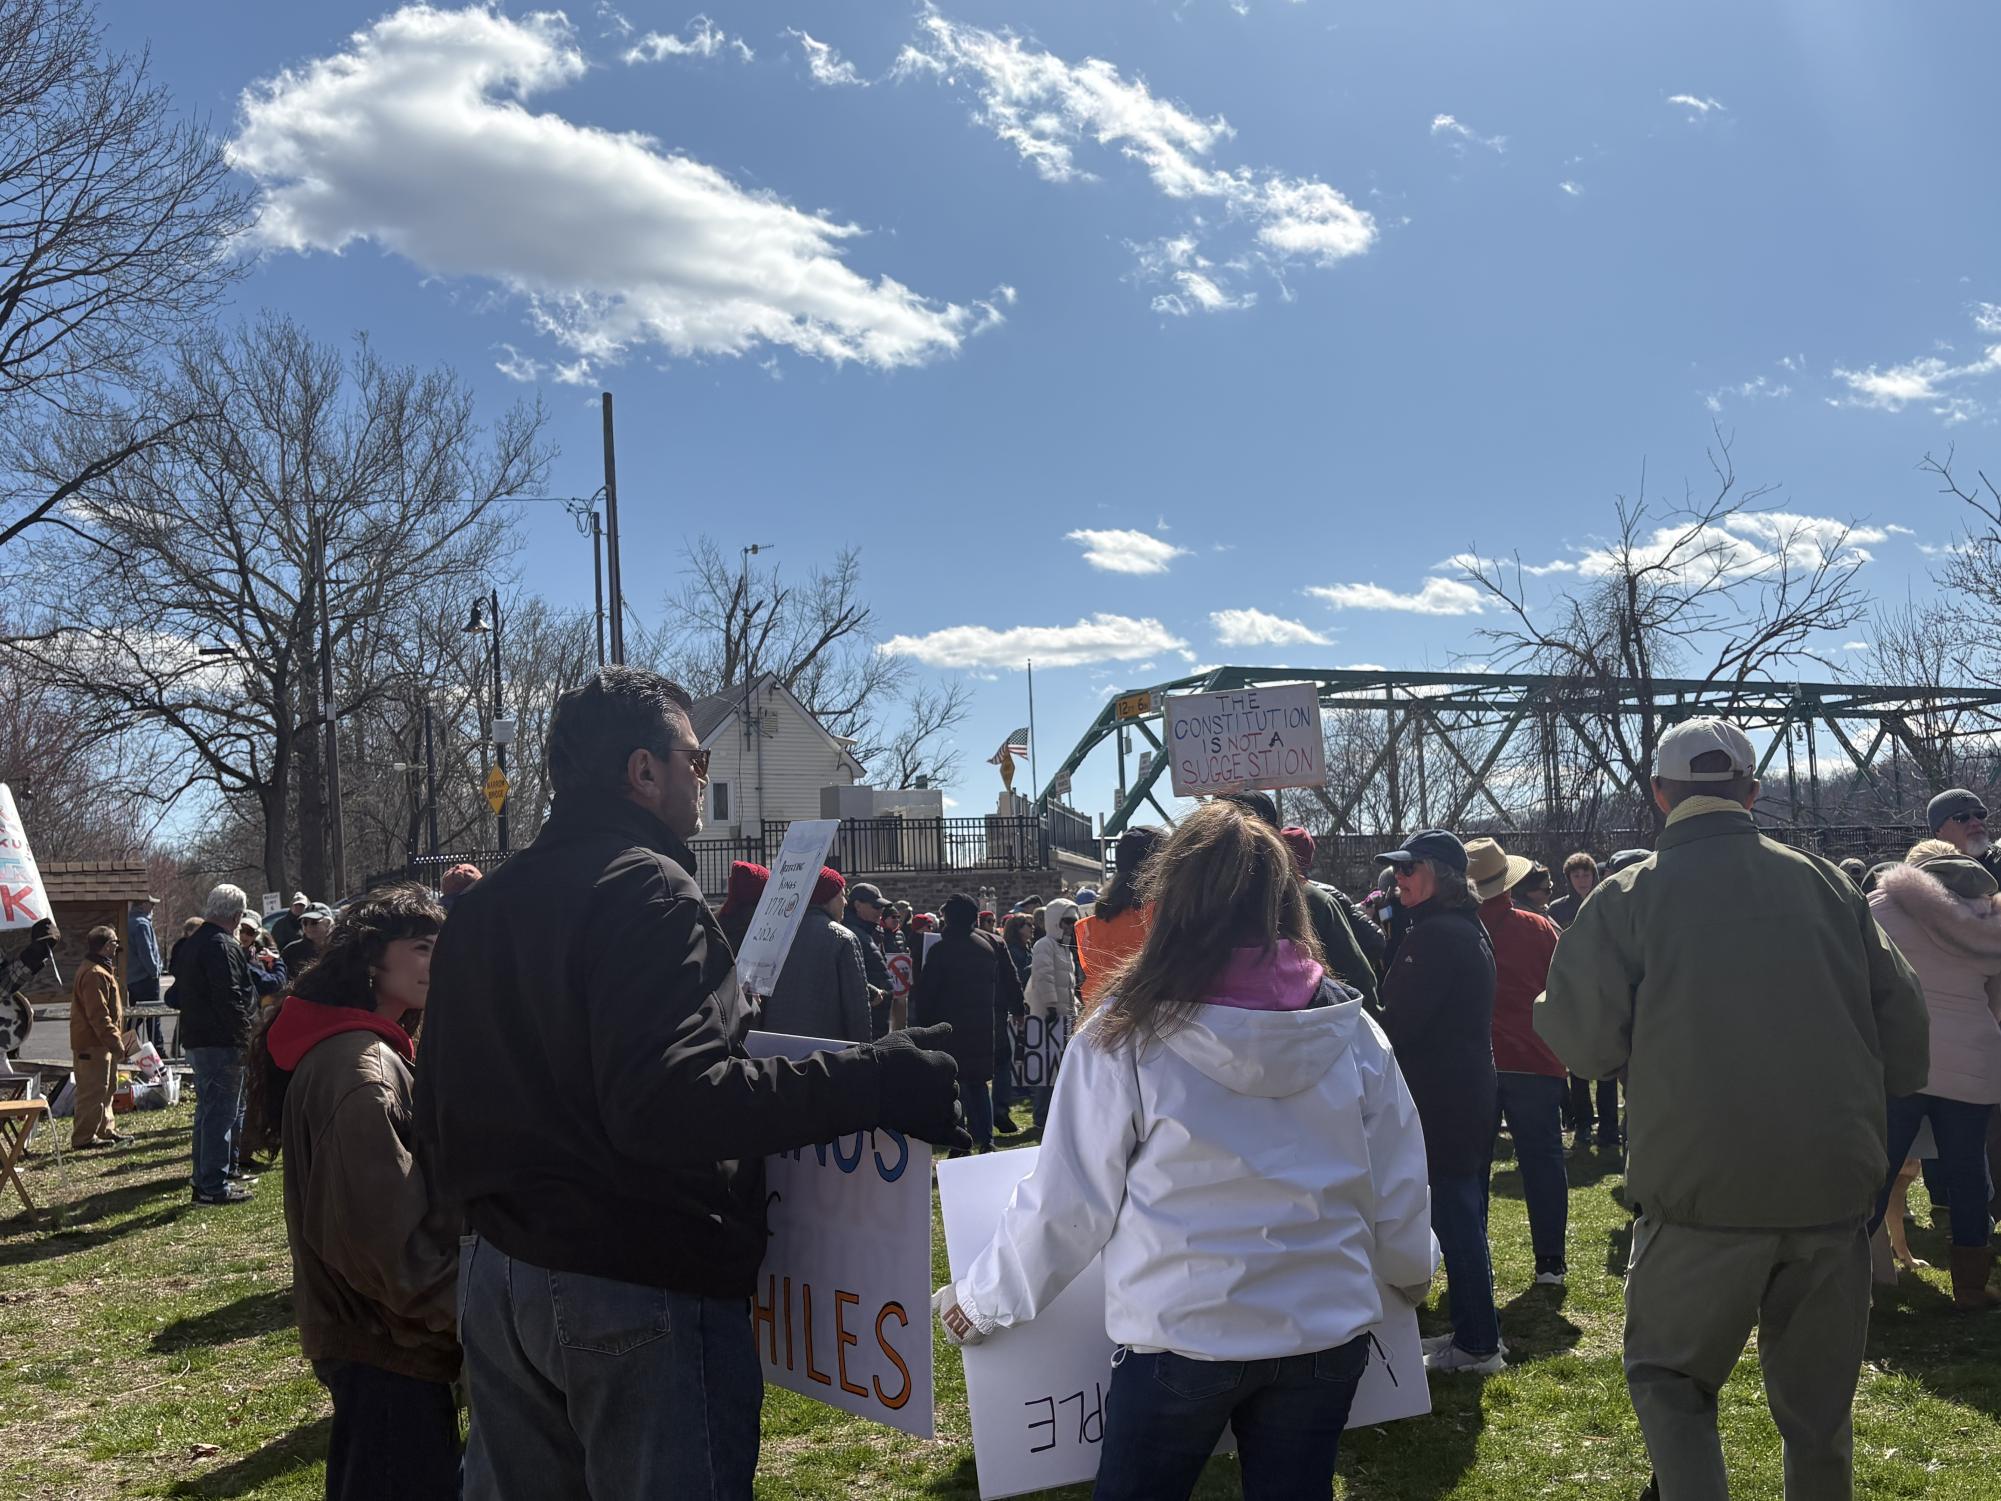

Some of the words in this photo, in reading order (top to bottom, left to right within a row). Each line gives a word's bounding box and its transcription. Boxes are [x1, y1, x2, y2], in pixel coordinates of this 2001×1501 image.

[1138, 697, 1144, 711] 6
[1216, 693, 1260, 712] THE
[1175, 706, 1311, 740] CONSTITUTION
[1202, 737, 1222, 754] IS
[1228, 732, 1262, 753] NOT
[1268, 731, 1284, 748] A
[1182, 746, 1313, 784] SUGGESTION
[764, 897, 786, 916] 1776
